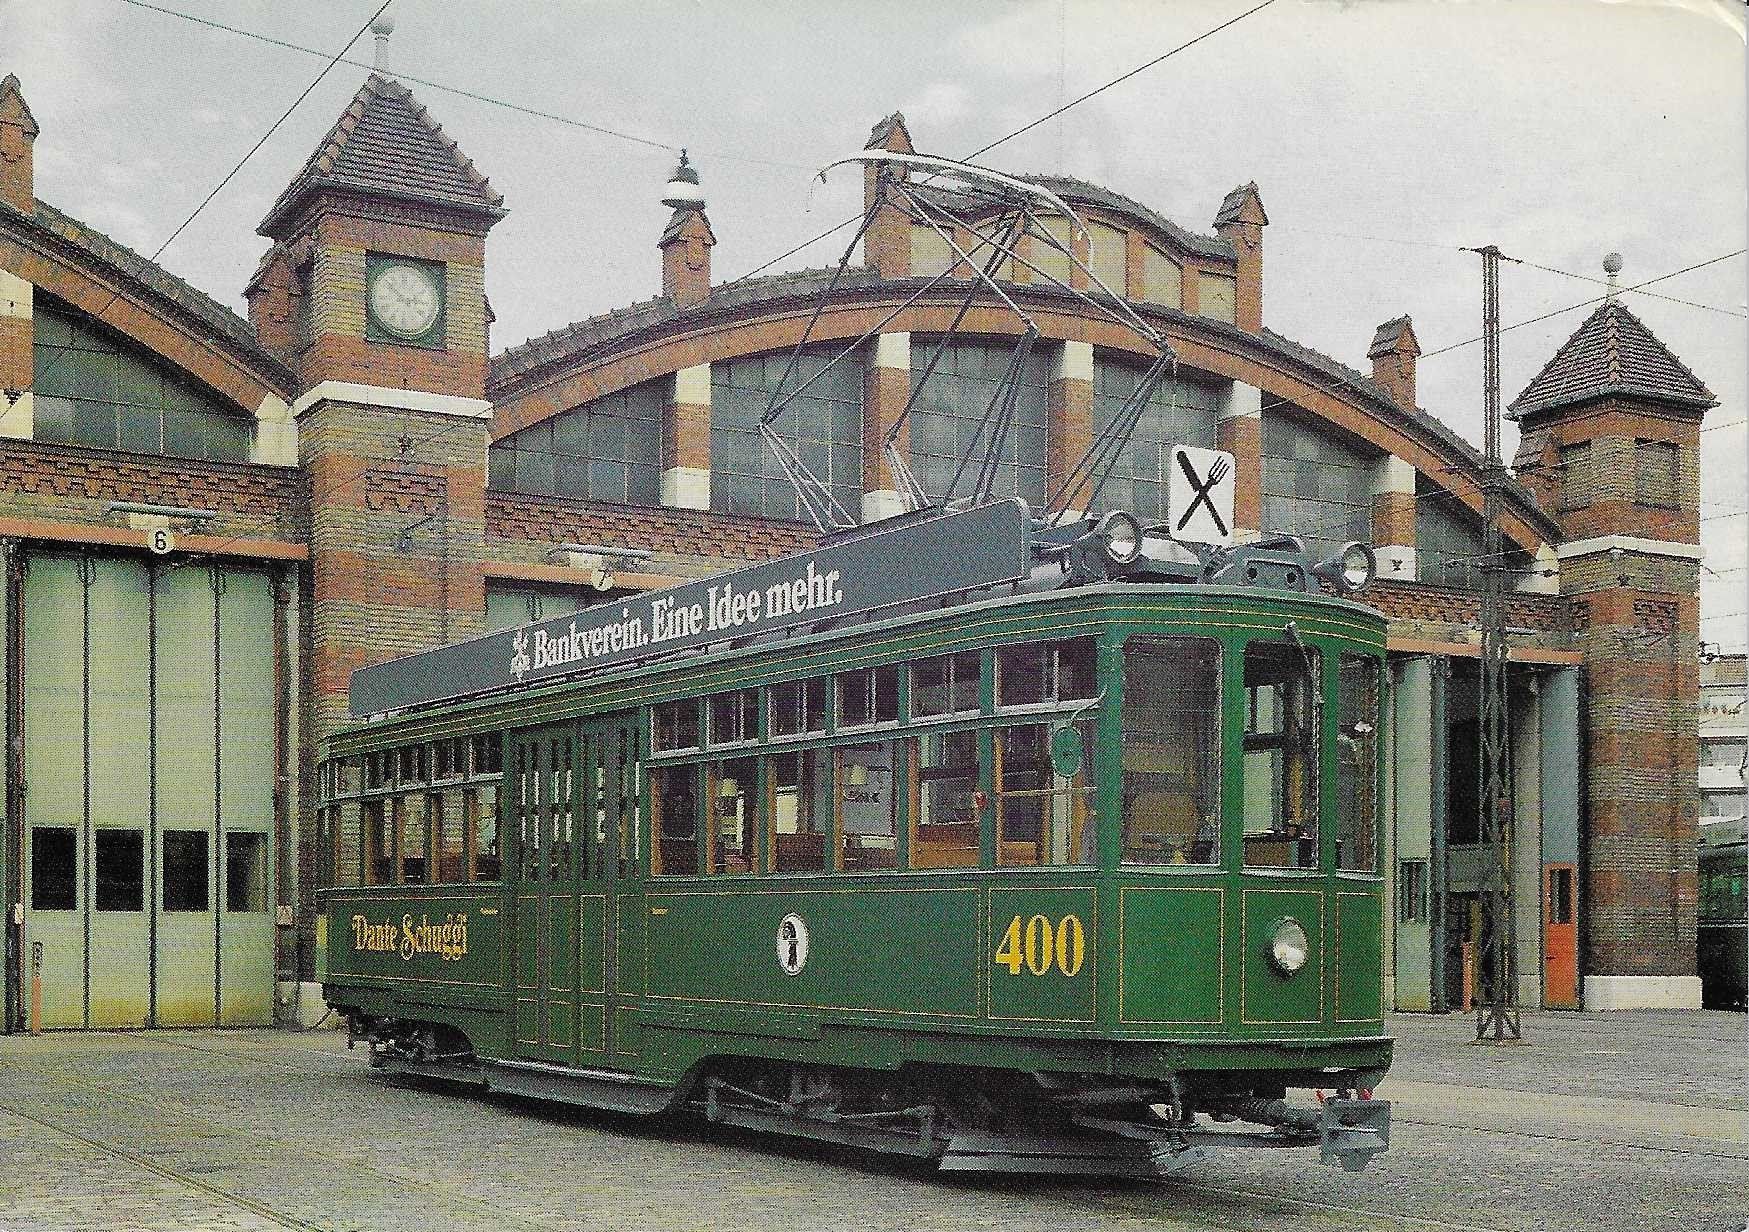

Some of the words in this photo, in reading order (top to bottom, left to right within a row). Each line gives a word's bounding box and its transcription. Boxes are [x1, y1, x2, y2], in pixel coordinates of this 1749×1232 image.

[155, 530, 167, 550] 6
[533, 608, 648, 669] Bankverein.
[652, 596, 703, 643] Eine
[707, 582, 760, 631] Idee
[766, 561, 842, 618] mehr.
[351, 914, 398, 950] Dante
[401, 913, 468, 960] Schuggi
[995, 914, 1085, 977] 400
